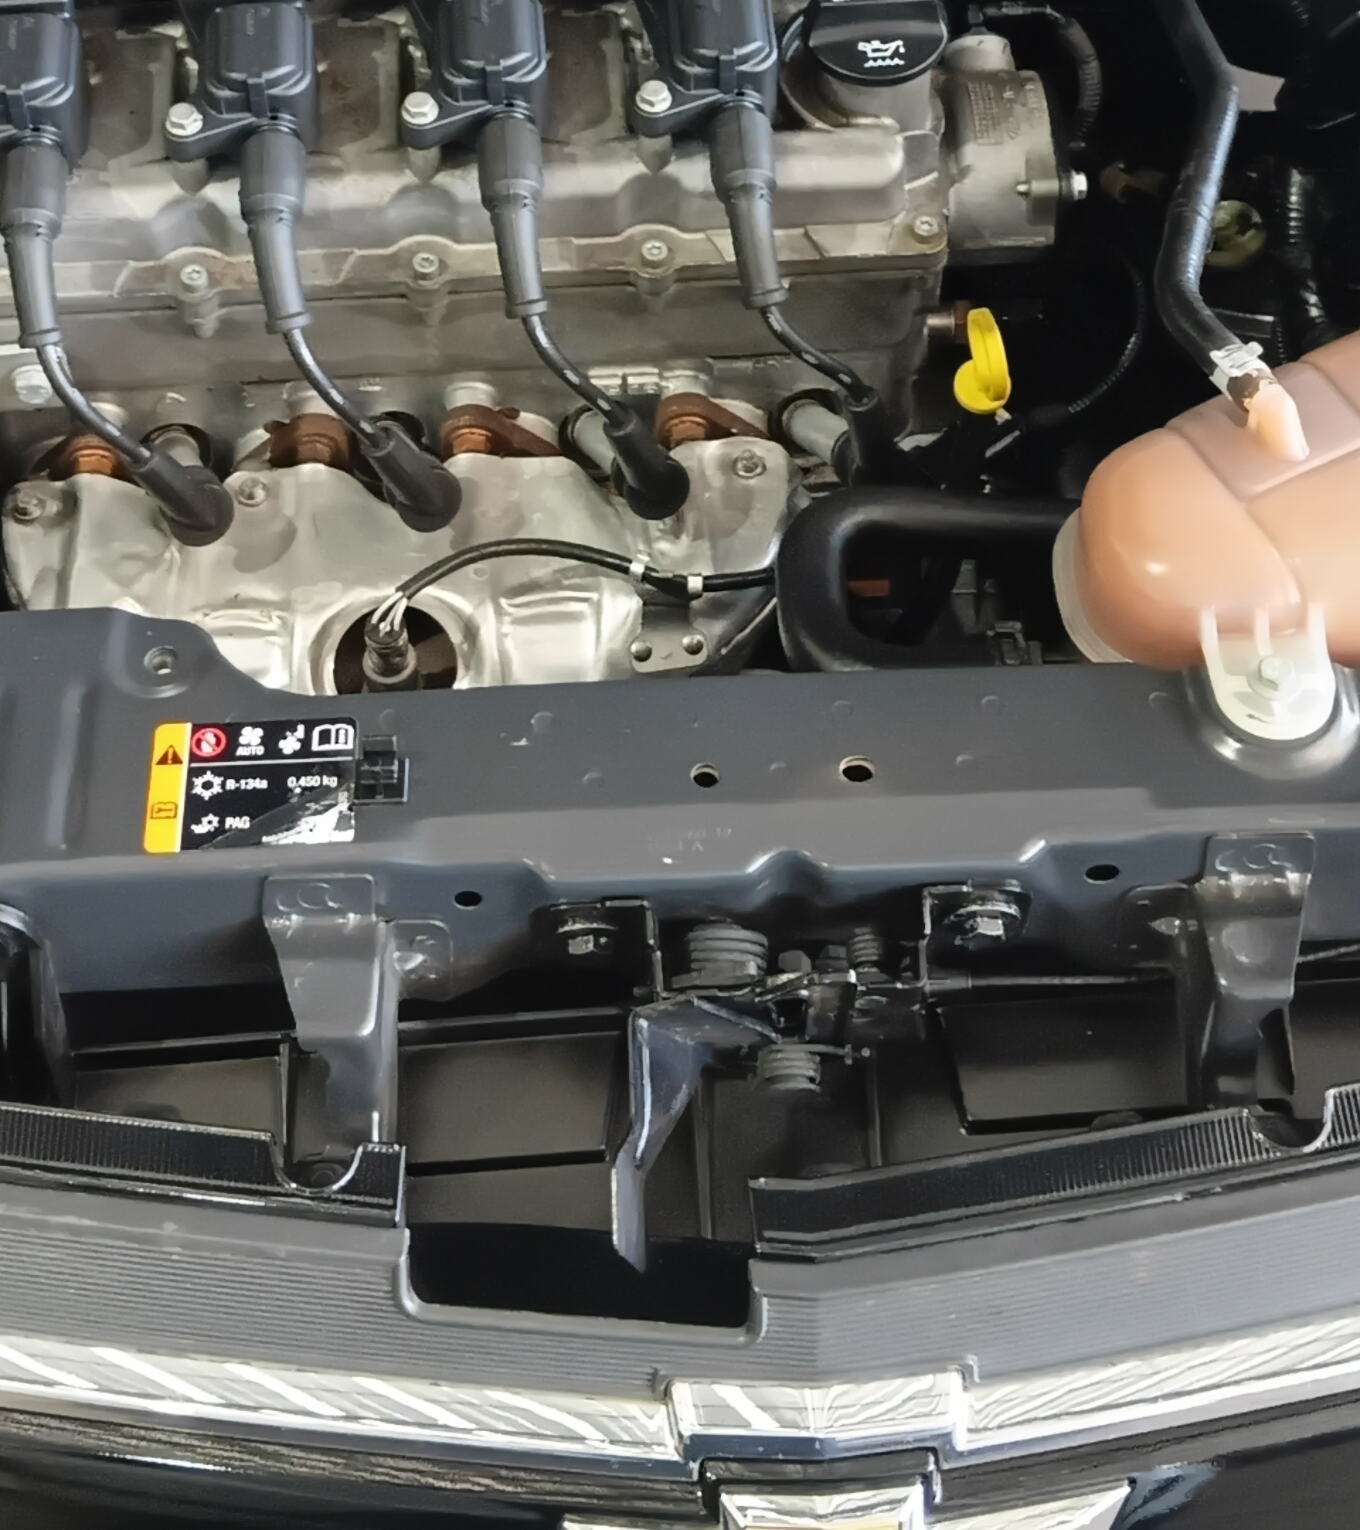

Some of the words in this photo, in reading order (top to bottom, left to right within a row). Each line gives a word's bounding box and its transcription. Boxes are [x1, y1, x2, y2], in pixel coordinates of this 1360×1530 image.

[236, 745, 265, 757] AUTO
[225, 778, 269, 791] R-134a
[322, 774, 339, 788] kg
[224, 816, 251, 830] PAG
